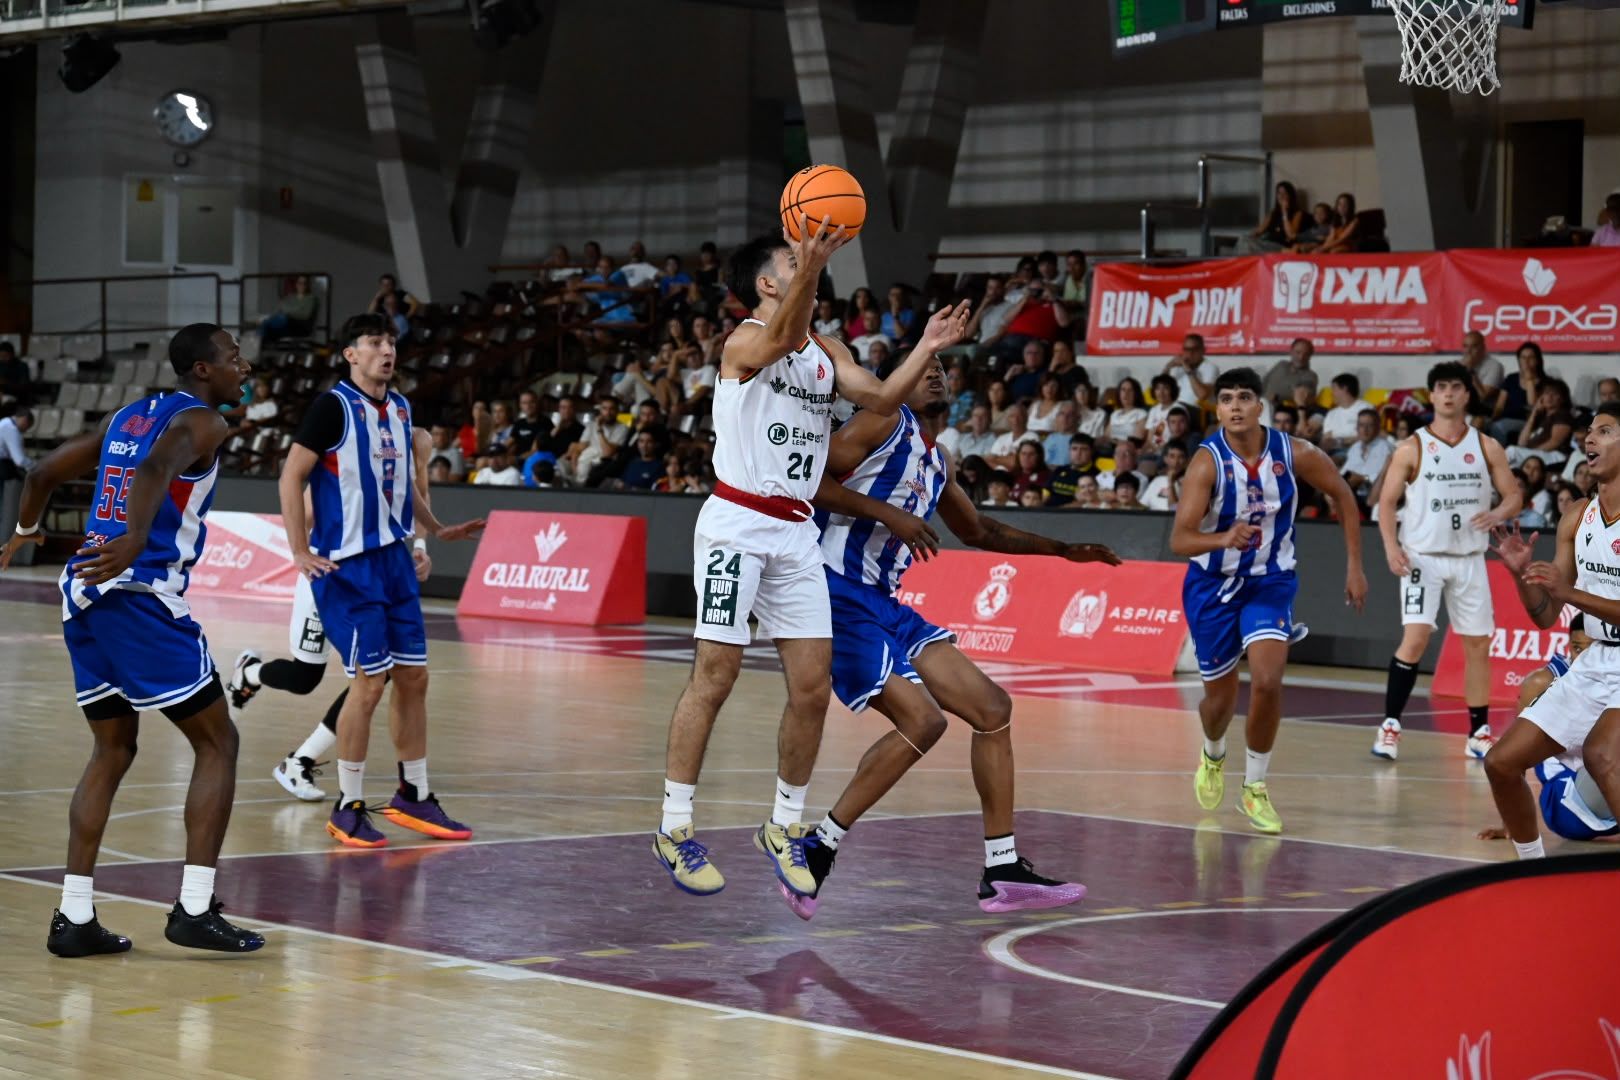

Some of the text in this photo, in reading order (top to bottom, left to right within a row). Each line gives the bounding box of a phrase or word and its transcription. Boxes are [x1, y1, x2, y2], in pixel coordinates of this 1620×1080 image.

[1220, 8, 1248, 20] FALTAS
[1283, 2, 1336, 16] EXCLUSIONES
[1116, 31, 1157, 48] MONDO
[1320, 266, 1428, 304] IXMA
[1098, 290, 1150, 329] BUN
[787, 452, 814, 481] 24
[96, 464, 135, 523] 55
[1451, 513, 1461, 530] 8
[707, 549, 741, 579] 24
[1411, 568, 1421, 584] 8
[710, 579, 733, 594] BUN
[705, 607, 731, 625] HAM
[1108, 606, 1180, 624] ASPIRE
[1112, 624, 1164, 635] ACADEMY
[1488, 628, 1541, 660] AJA
